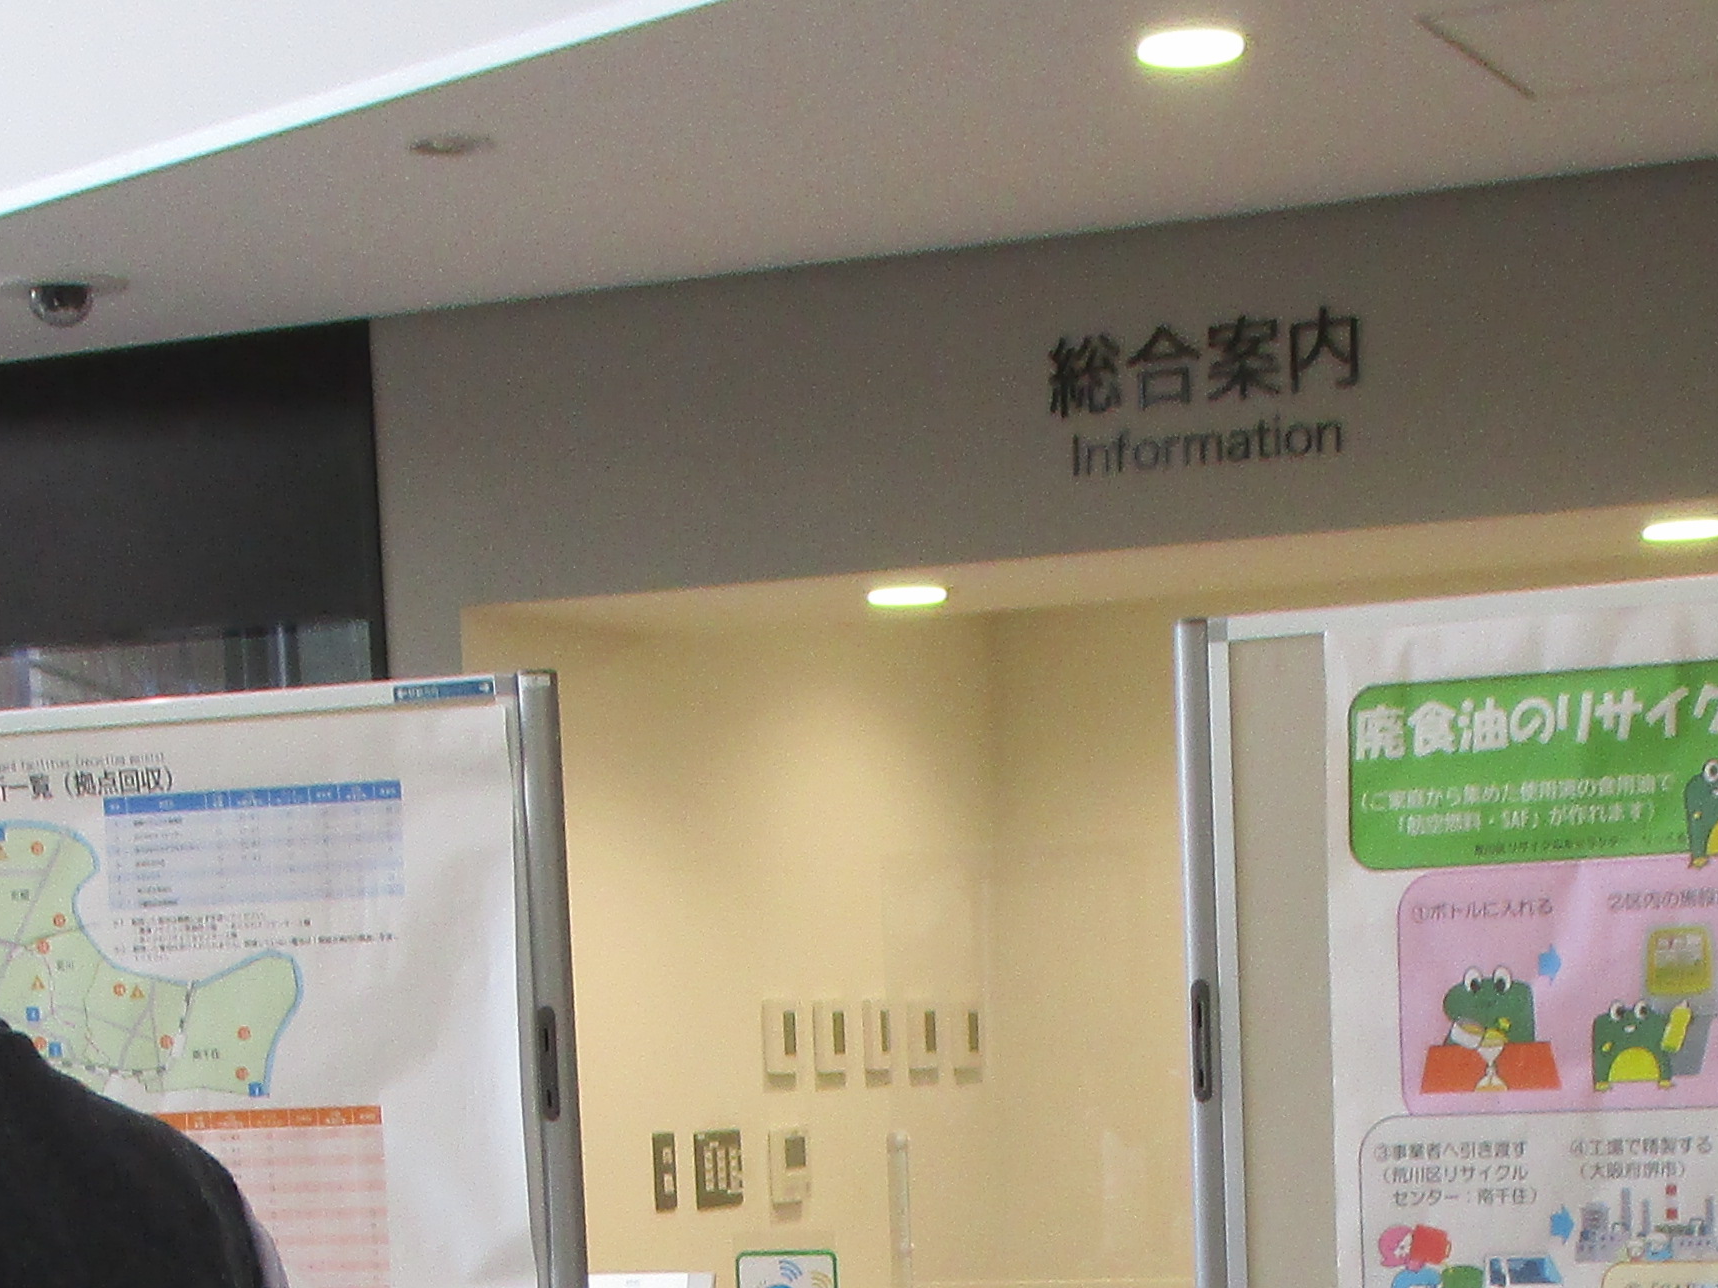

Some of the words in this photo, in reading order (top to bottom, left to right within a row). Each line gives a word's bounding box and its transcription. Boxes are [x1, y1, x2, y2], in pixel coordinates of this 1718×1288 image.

[1047, 305, 1361, 419] 総合案内
[1072, 412, 1344, 477] Information
